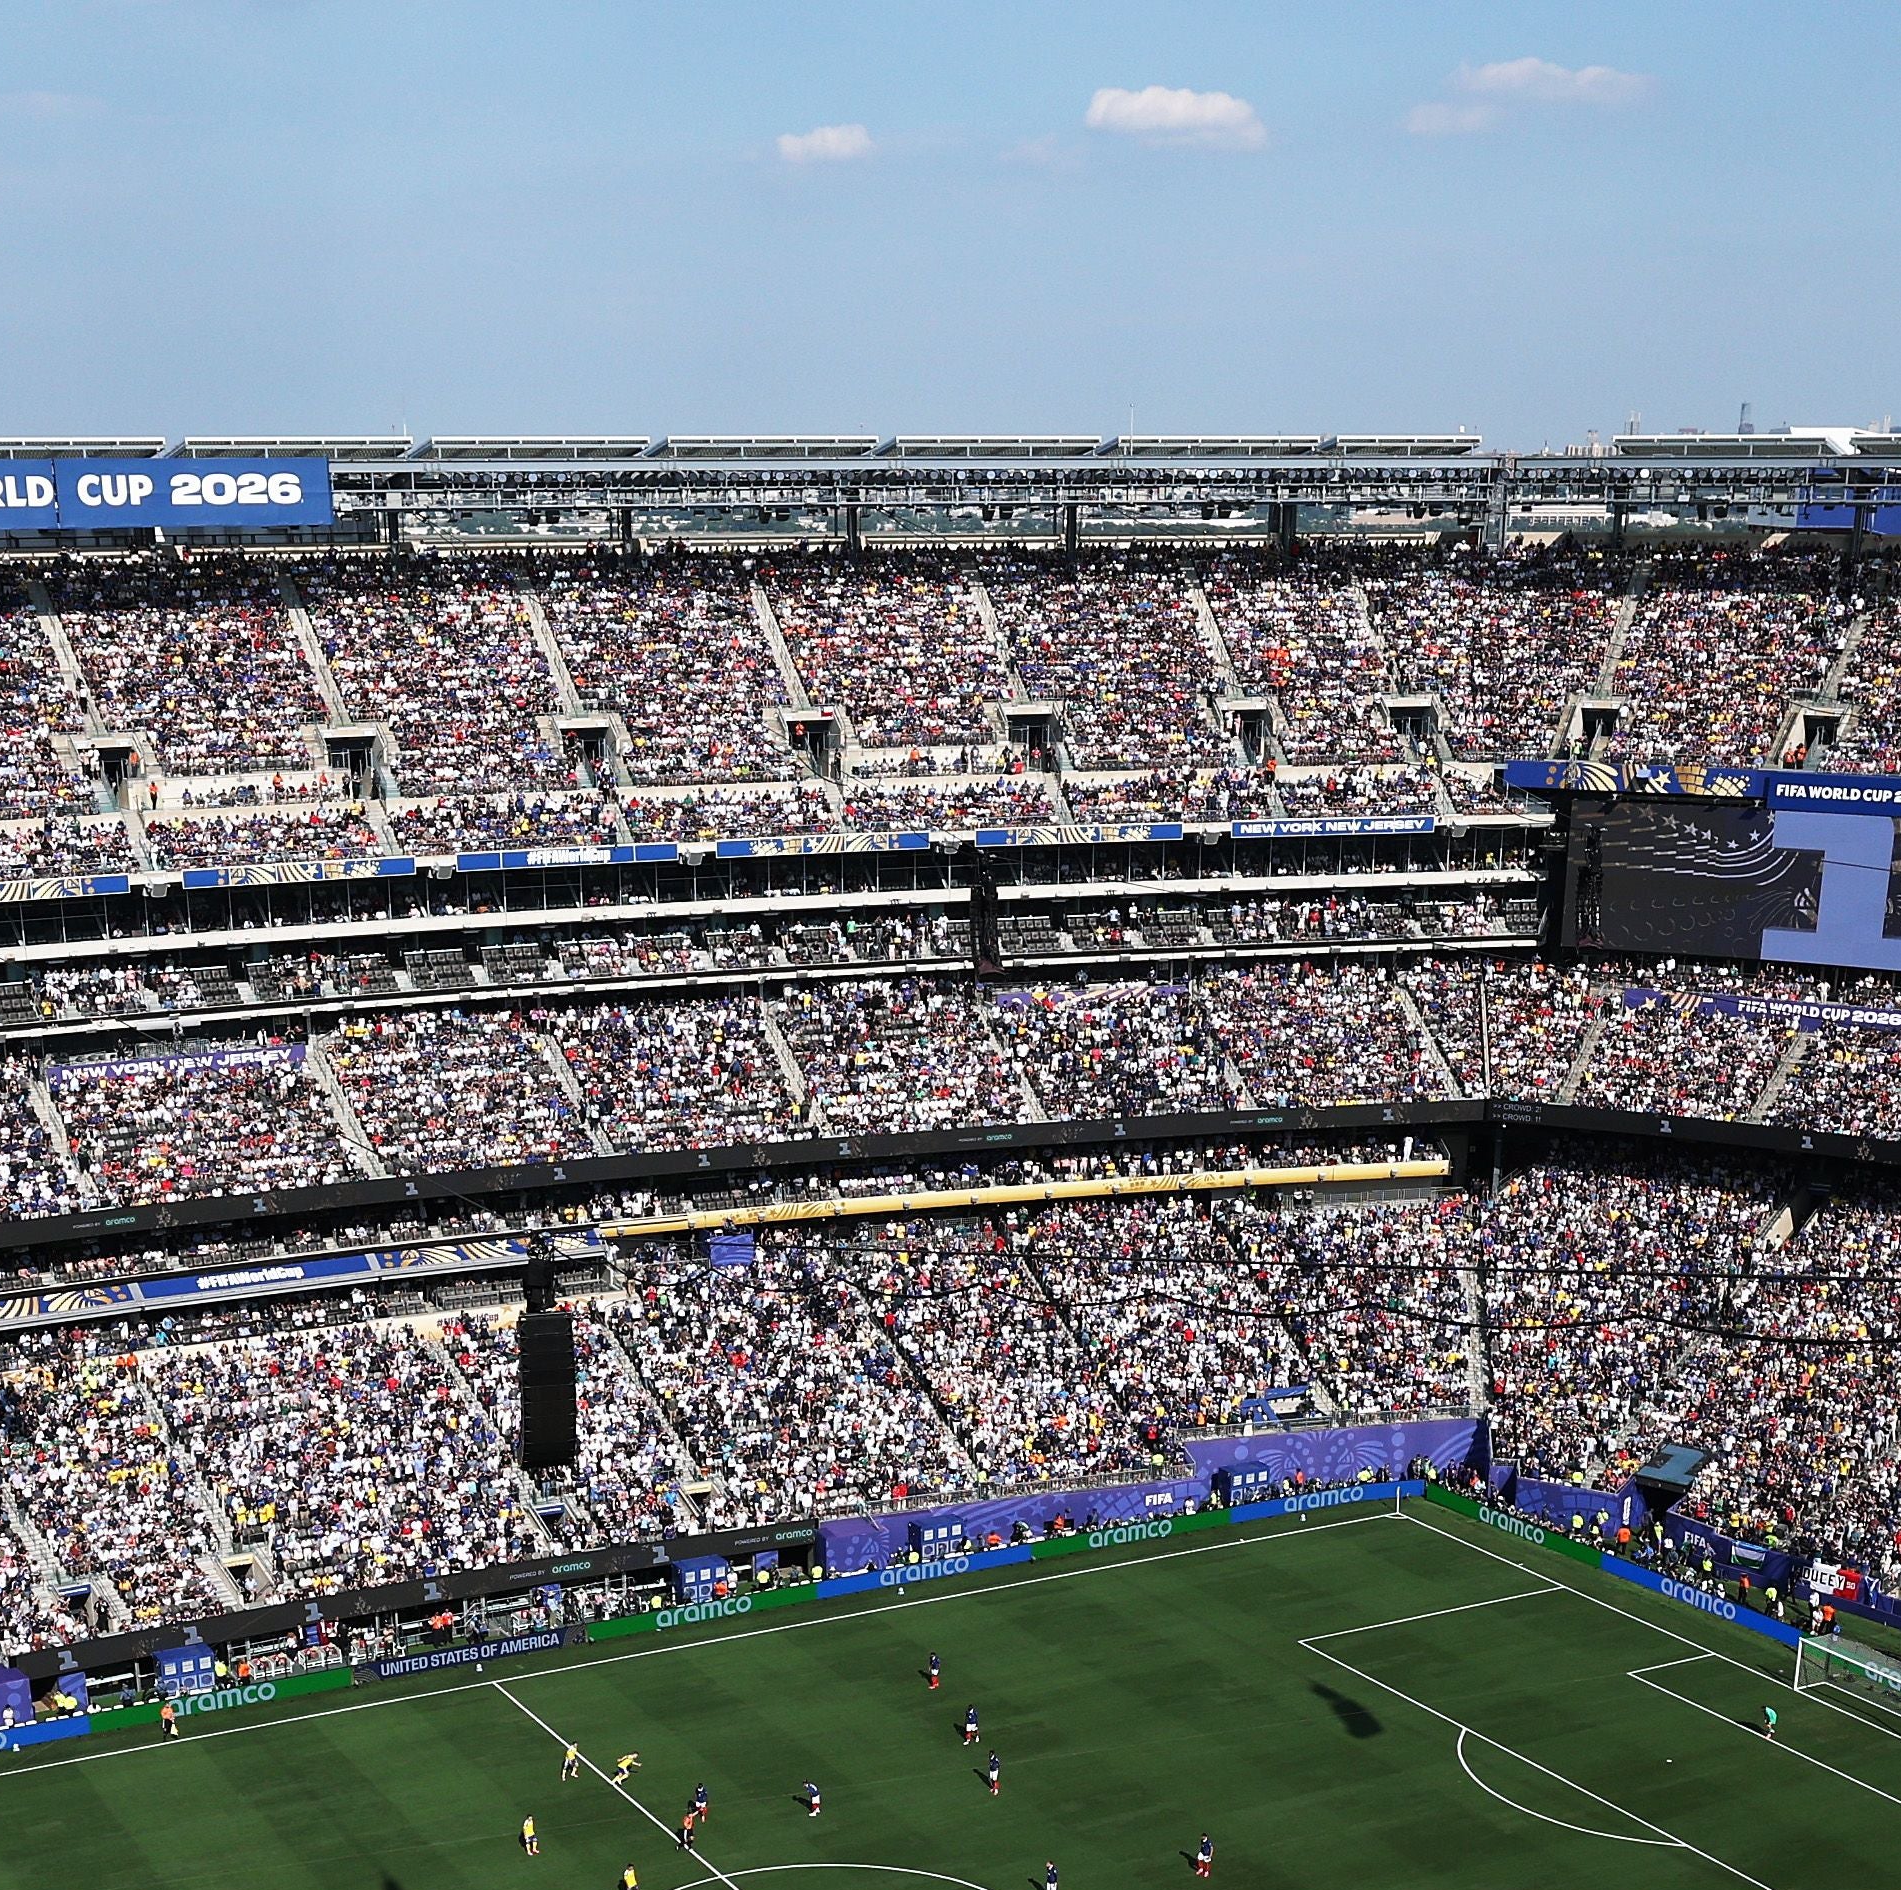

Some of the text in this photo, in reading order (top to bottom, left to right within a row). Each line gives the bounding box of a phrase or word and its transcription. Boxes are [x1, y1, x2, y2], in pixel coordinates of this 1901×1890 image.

[77, 472, 154, 506] CUP
[170, 471, 302, 505] 2026
[1776, 783, 1805, 799] FIFA
[1808, 784, 1861, 803] WORLD
[1862, 788, 1893, 804] CUP
[1240, 818, 1427, 834] NEW YORK NEW JERSEY
[526, 849, 612, 867] #FIFAWorldCup
[1821, 1005, 1851, 1021] CUP
[168, 1056, 210, 1073] NEW
[215, 1048, 294, 1069] JERSEY
[1382, 1108, 1394, 1120] 1
[1114, 1123, 1126, 1135] 1
[1659, 1119, 1671, 1133] 1
[838, 1140, 851, 1155] 1
[1801, 1135, 1813, 1149] 1
[698, 1153, 710, 1167] 1
[553, 1167, 566, 1180] 1
[405, 1182, 418, 1195] 1
[252, 1196, 267, 1212] 1
[105, 1216, 136, 1226] aramco
[196, 1266, 305, 1290] #FIFAWorldCup
[1145, 1492, 1174, 1507] FIFA
[1284, 1485, 1364, 1514] aramco
[775, 1528, 813, 1541] aramco
[1088, 1519, 1173, 1549] aramco
[1478, 1506, 1545, 1545] aramco
[1684, 1531, 1708, 1549] FIFA
[651, 1545, 669, 1563] 1
[551, 1561, 591, 1574] aramco
[879, 1556, 969, 1587] aramco
[1801, 1567, 1844, 1590] DUCEY
[423, 1581, 442, 1601] 1
[1660, 1577, 1738, 1621] aramco
[304, 1602, 323, 1621] 1
[656, 1595, 752, 1628] aramco
[182, 1625, 203, 1645] 1
[57, 1650, 78, 1670] 1
[380, 1633, 559, 1678] UNITED STATES OF AMERICA
[167, 1682, 276, 1717] aramco
